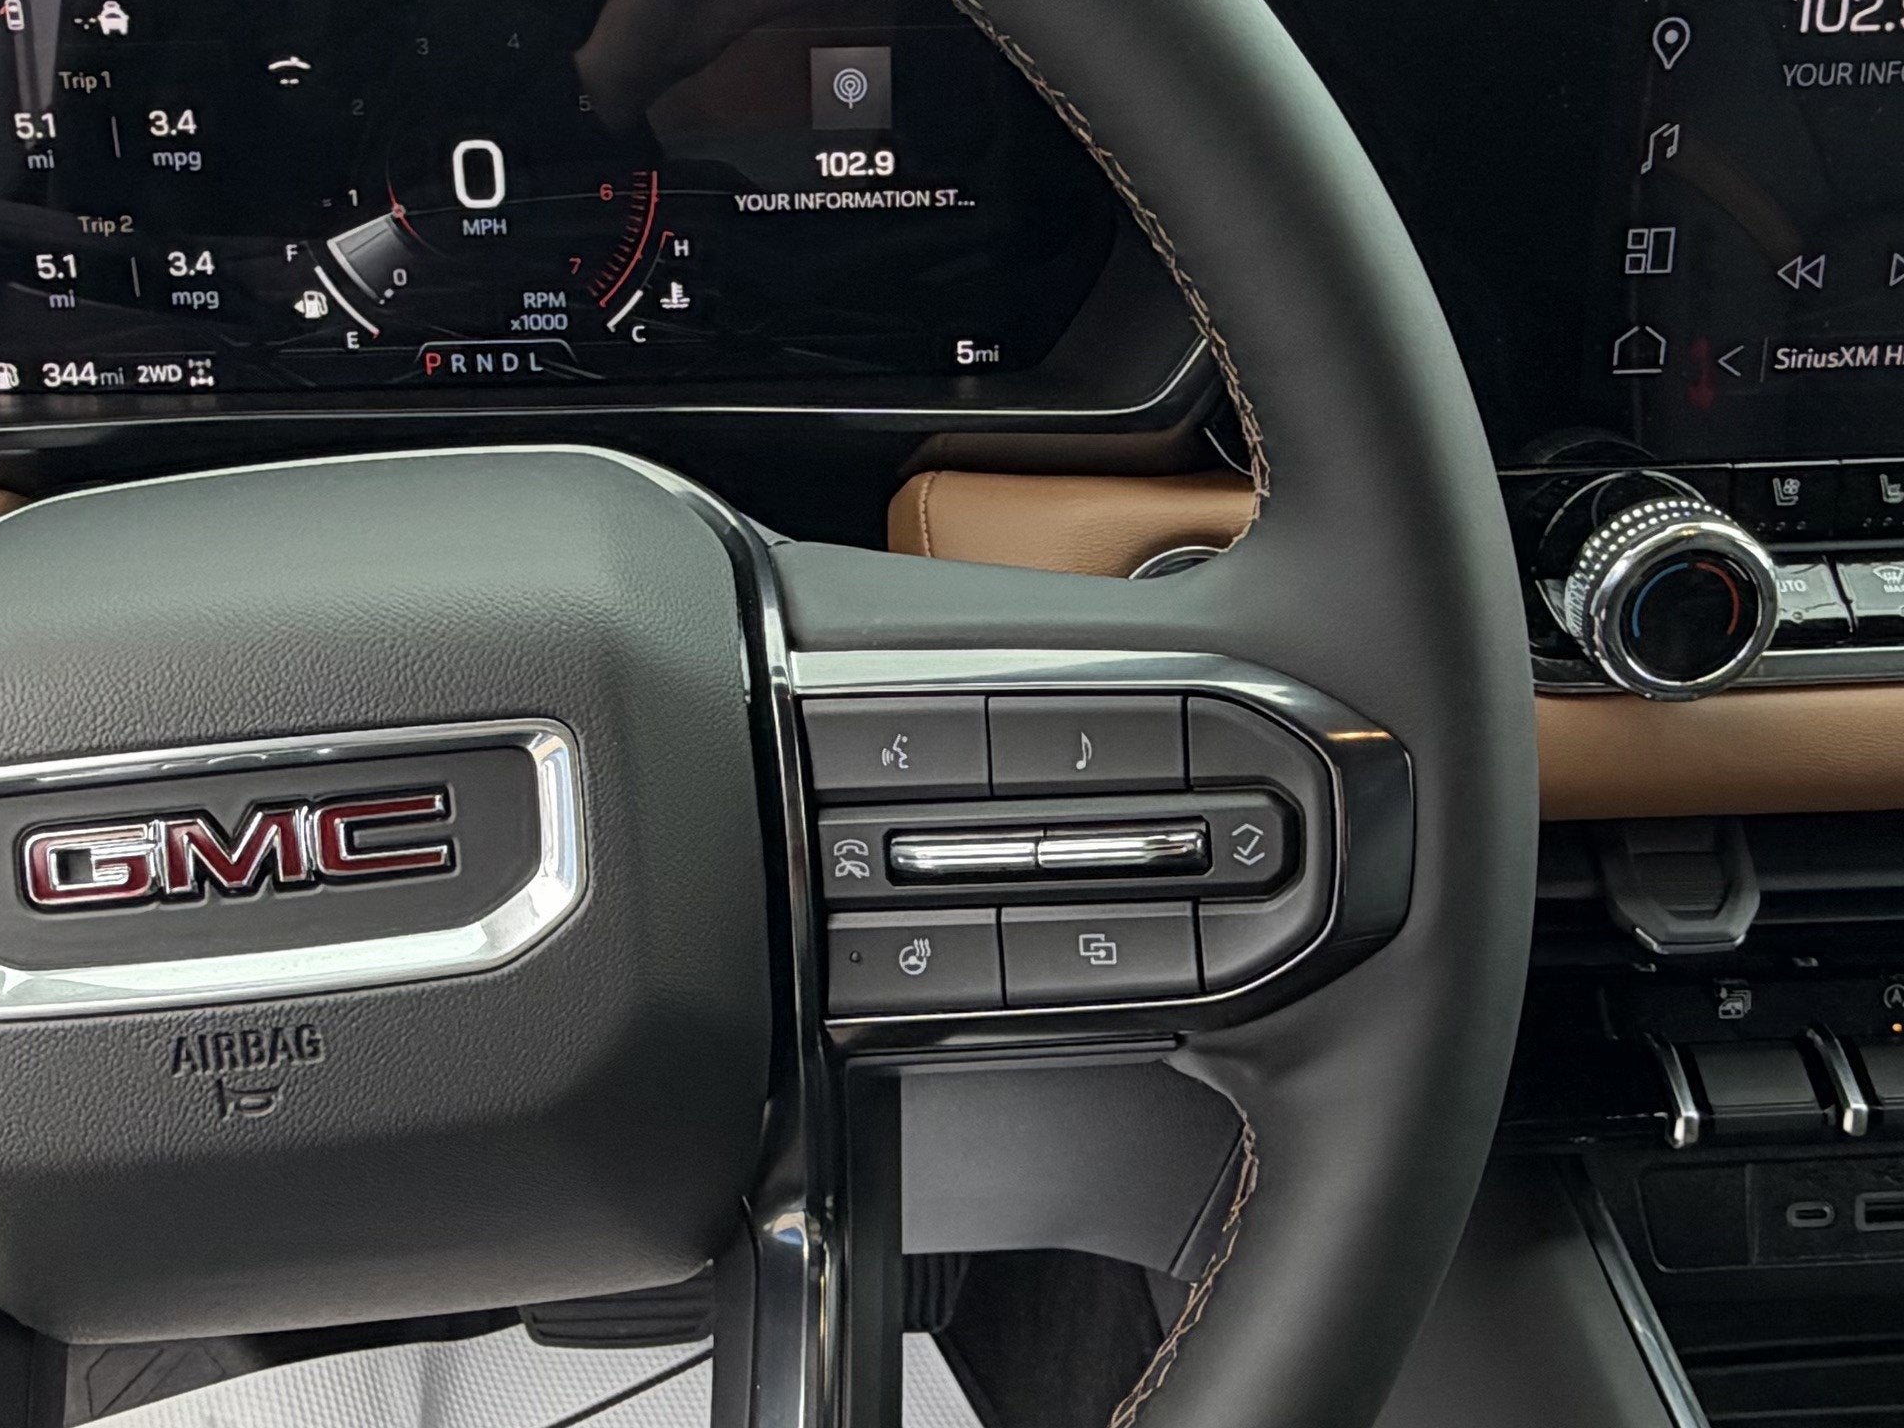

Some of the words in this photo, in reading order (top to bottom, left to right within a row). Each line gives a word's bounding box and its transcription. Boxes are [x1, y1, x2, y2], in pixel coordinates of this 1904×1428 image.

[59, 72, 98, 91] Trip
[103, 71, 112, 88] 1
[1783, 61, 1853, 87] YOUR
[14, 114, 56, 139] 5.1
[149, 110, 197, 136] 3.4
[28, 149, 54, 169] mi
[153, 150, 202, 171] mpg
[816, 152, 895, 177] 102.9
[453, 140, 505, 209] 0
[735, 194, 790, 213] YOUR
[795, 190, 931, 210] INFORMATION
[78, 217, 116, 238] Trip
[120, 216, 133, 233] 2
[463, 220, 507, 236] MPH
[287, 245, 297, 261] F
[675, 240, 689, 257] H
[36, 254, 78, 279] 5.1
[168, 252, 215, 276] 3.4
[49, 289, 75, 309] mi
[172, 290, 219, 310] mpg
[523, 292, 566, 308] RPM
[348, 332, 358, 349] E
[632, 326, 646, 344] C
[426, 354, 441, 375] P
[451, 354, 467, 373] R
[478, 354, 493, 372] N
[503, 353, 519, 372] D
[530, 352, 543, 372] L
[1774, 344, 1879, 370] SiriusXM
[137, 366, 182, 383] 2WD
[1776, 580, 1808, 593] UTO
[25, 789, 456, 906] GMC
[170, 1022, 324, 1078] AIRBAG
